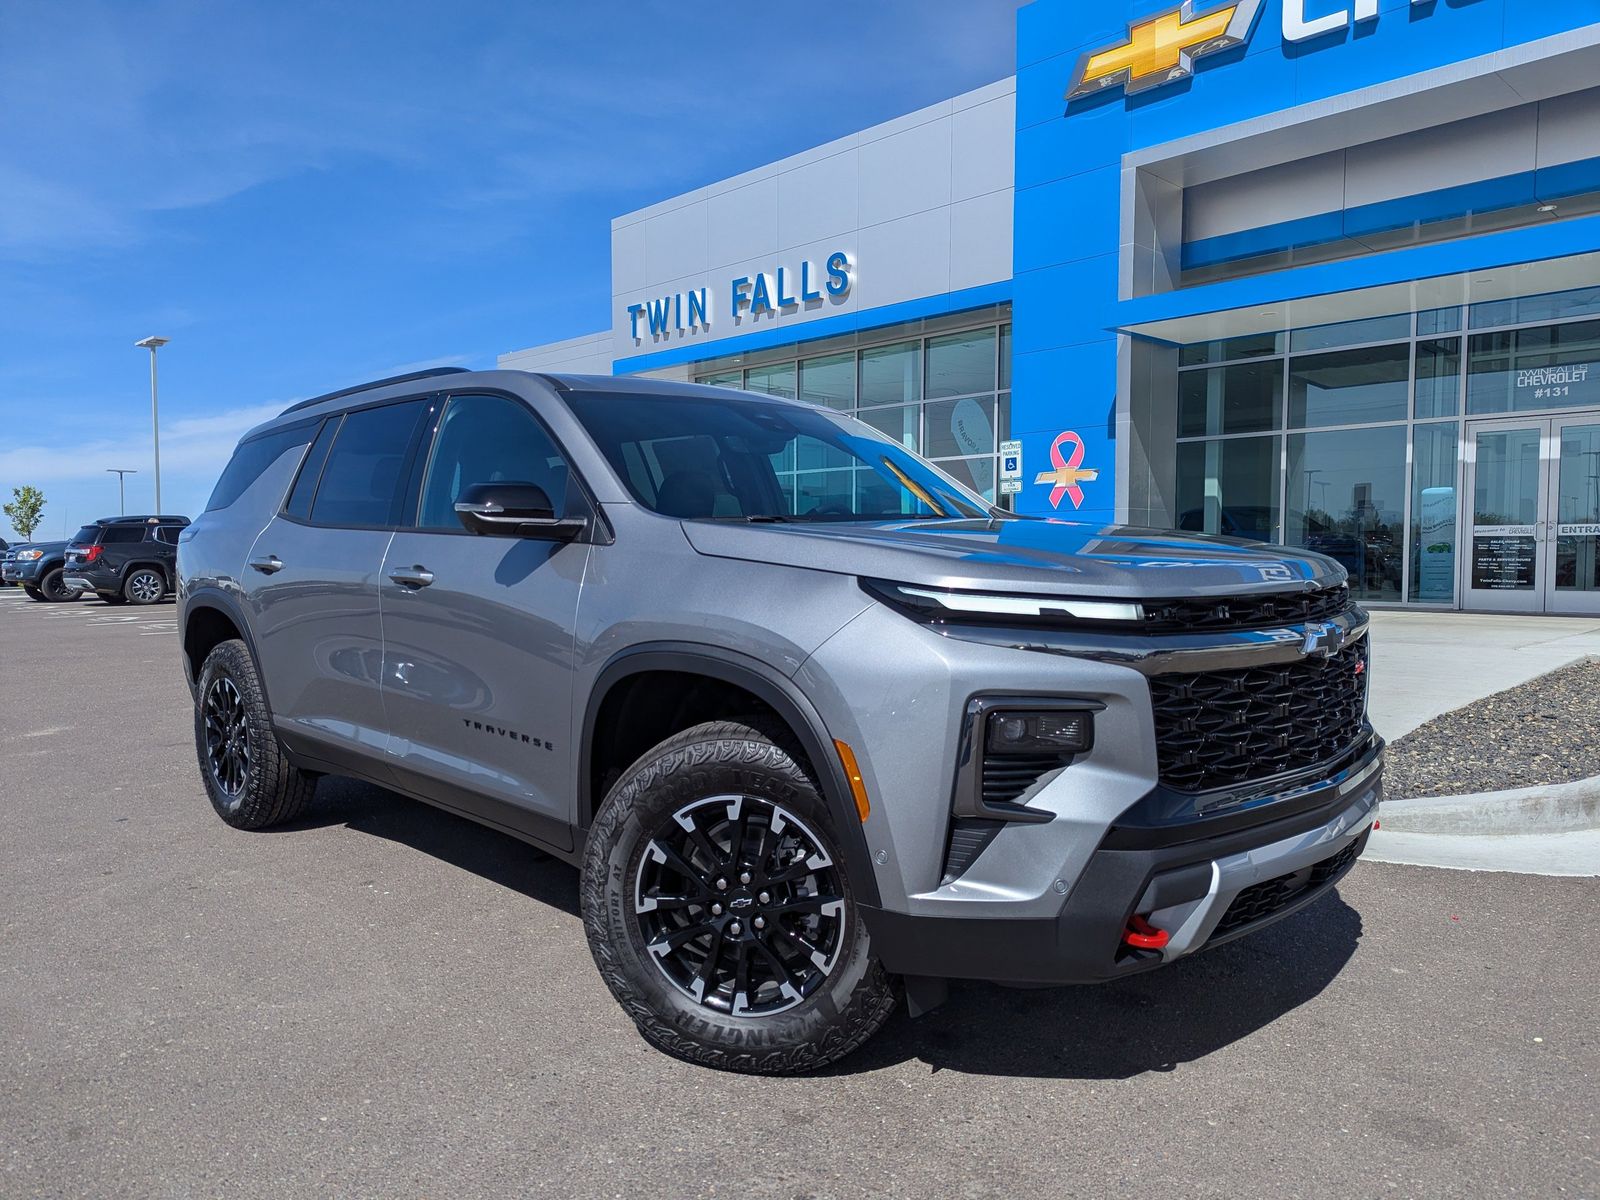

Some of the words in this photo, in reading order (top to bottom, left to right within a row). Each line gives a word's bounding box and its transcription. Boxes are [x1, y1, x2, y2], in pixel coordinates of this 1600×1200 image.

[627, 287, 709, 339] TWIN
[731, 251, 850, 319] FALLS
[1517, 370, 1588, 387] CHEVROLET
[1534, 386, 1569, 398] #131
[463, 719, 553, 751] TRAVERSE
